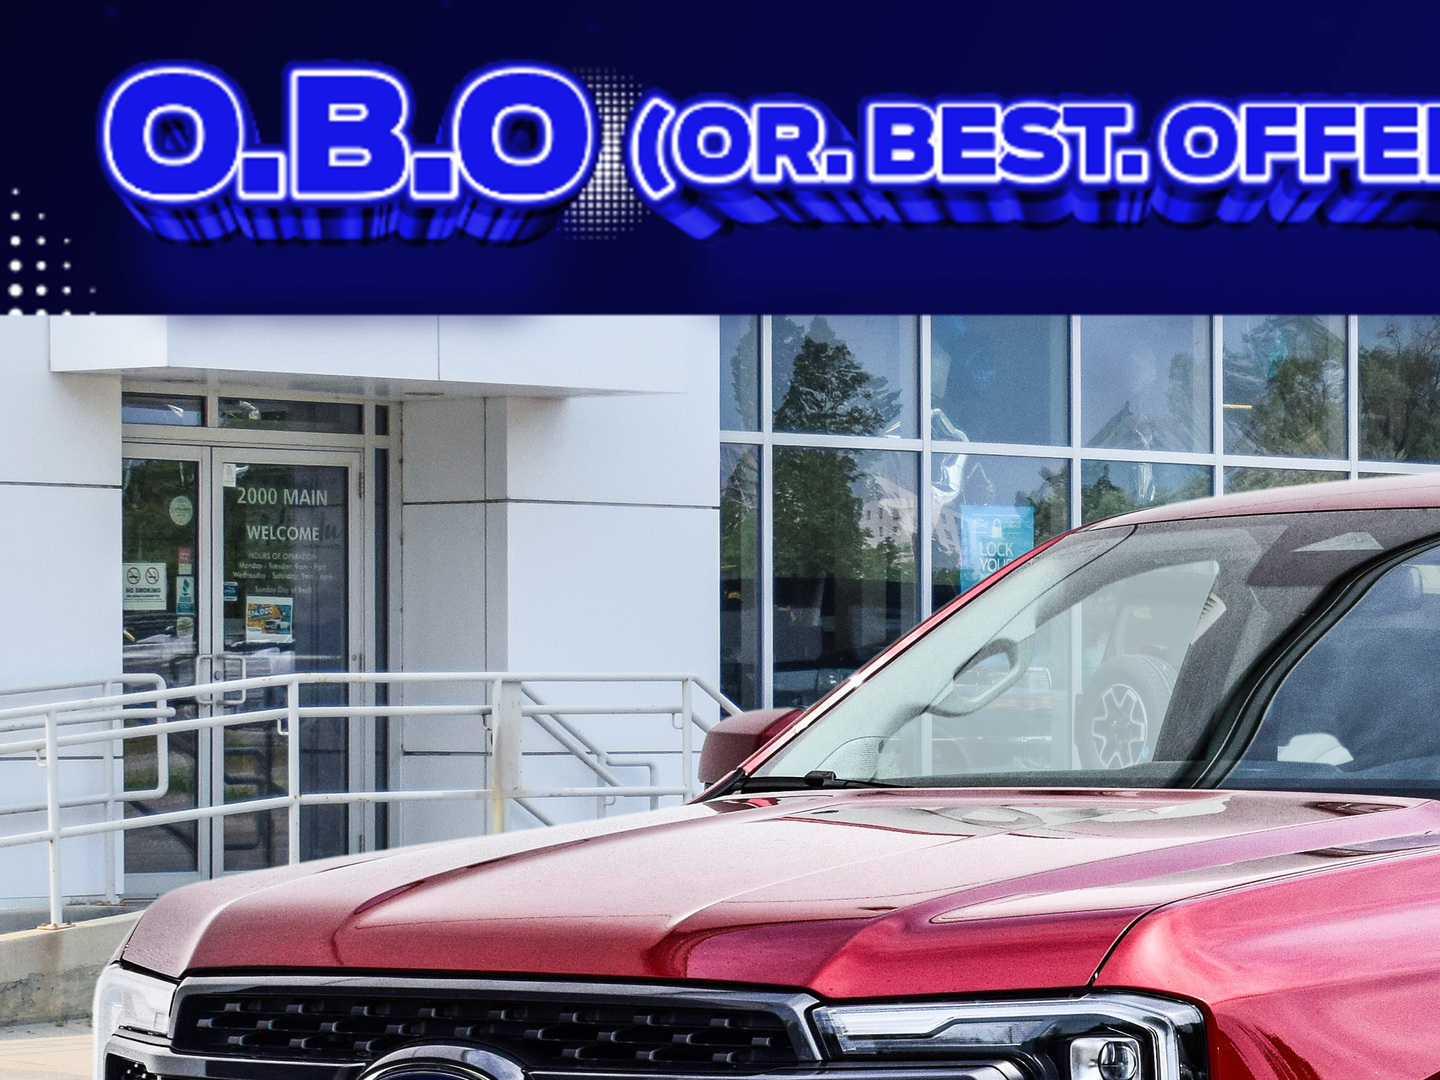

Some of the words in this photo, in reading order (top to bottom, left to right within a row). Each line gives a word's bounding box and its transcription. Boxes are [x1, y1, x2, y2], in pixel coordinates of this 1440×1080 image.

[237, 487, 277, 505] 2000
[283, 488, 328, 506] MAIN
[246, 525, 320, 541] WELCOME
[979, 541, 1014, 557] LOCK
